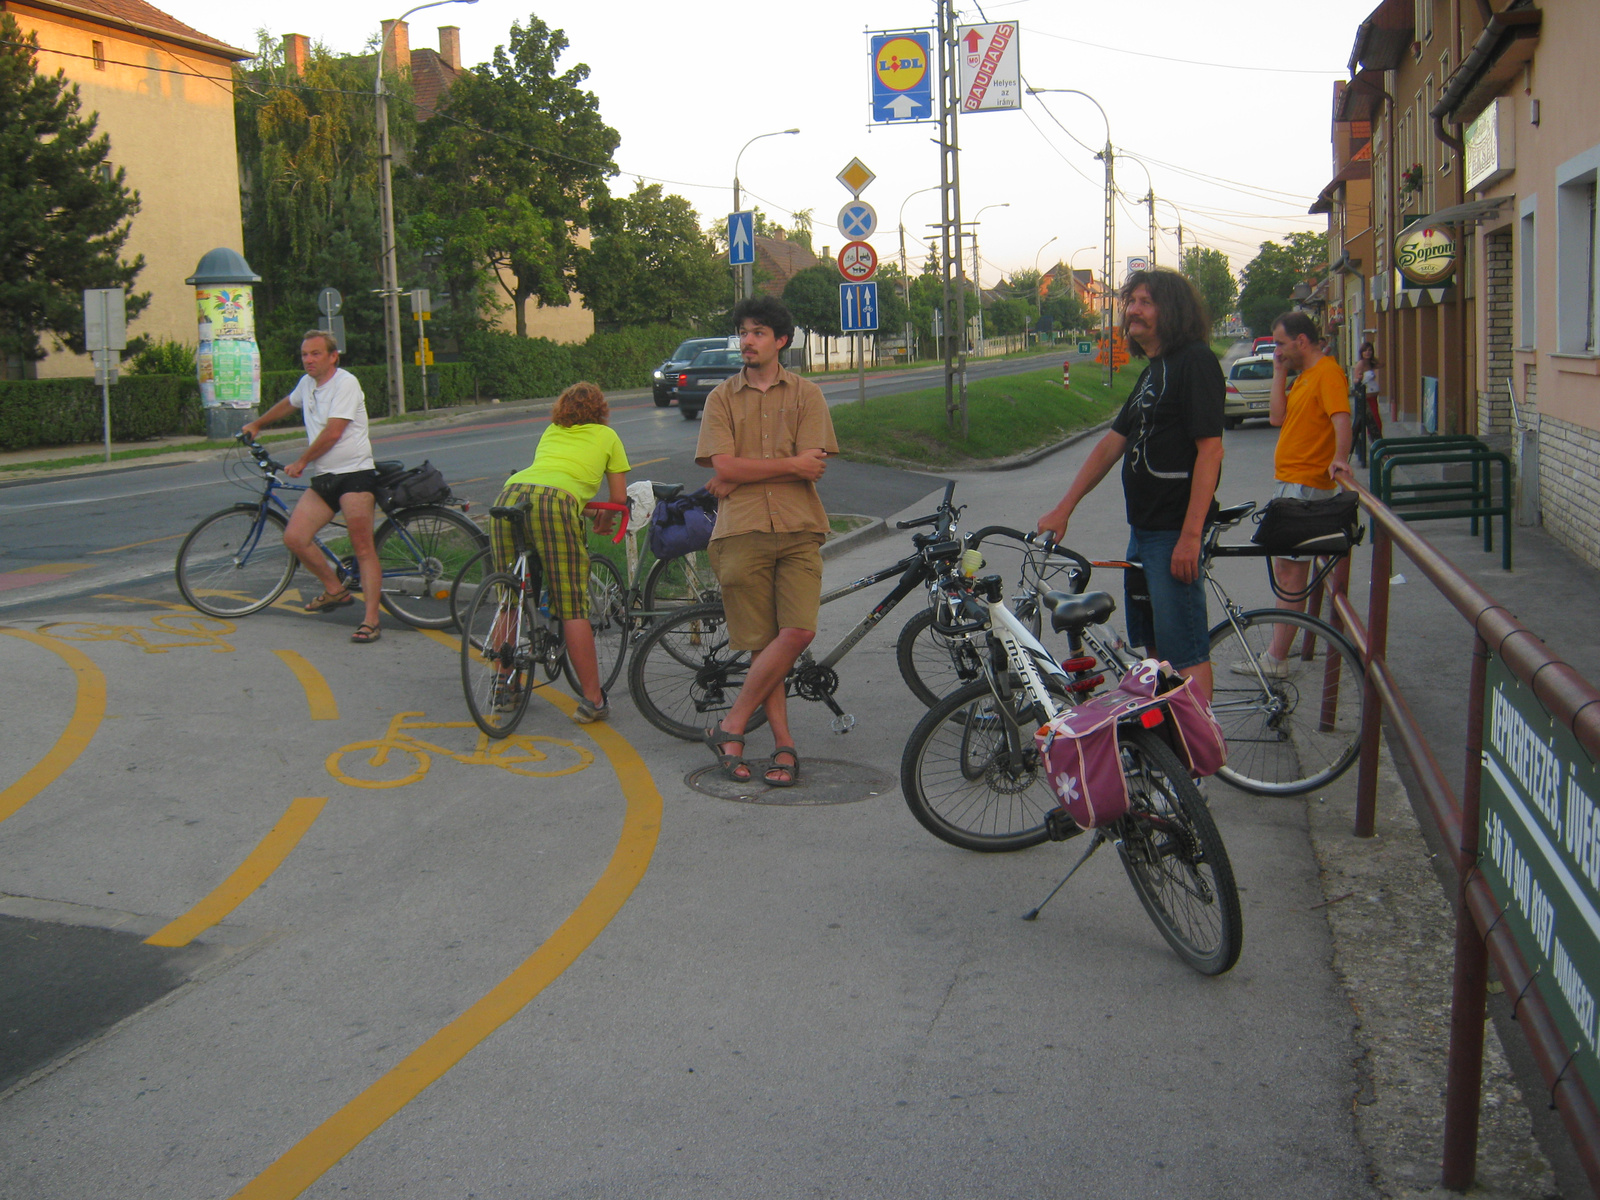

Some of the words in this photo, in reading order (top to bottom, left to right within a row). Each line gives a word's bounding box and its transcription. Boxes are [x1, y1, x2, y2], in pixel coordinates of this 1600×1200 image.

[966, 24, 1014, 110] BAUHAUS
[993, 79, 1017, 88] Helyes
[996, 98, 1015, 107] irány
[1399, 241, 1456, 267] Soproni
[1080, 629, 1125, 679] UGEOT
[1491, 681, 1562, 843] KÉPKERETEZÉS,
[1484, 807, 1503, 869] +36
[1502, 828, 1513, 889] 70
[1513, 848, 1531, 920] 940
[1531, 879, 1554, 961] 8197
